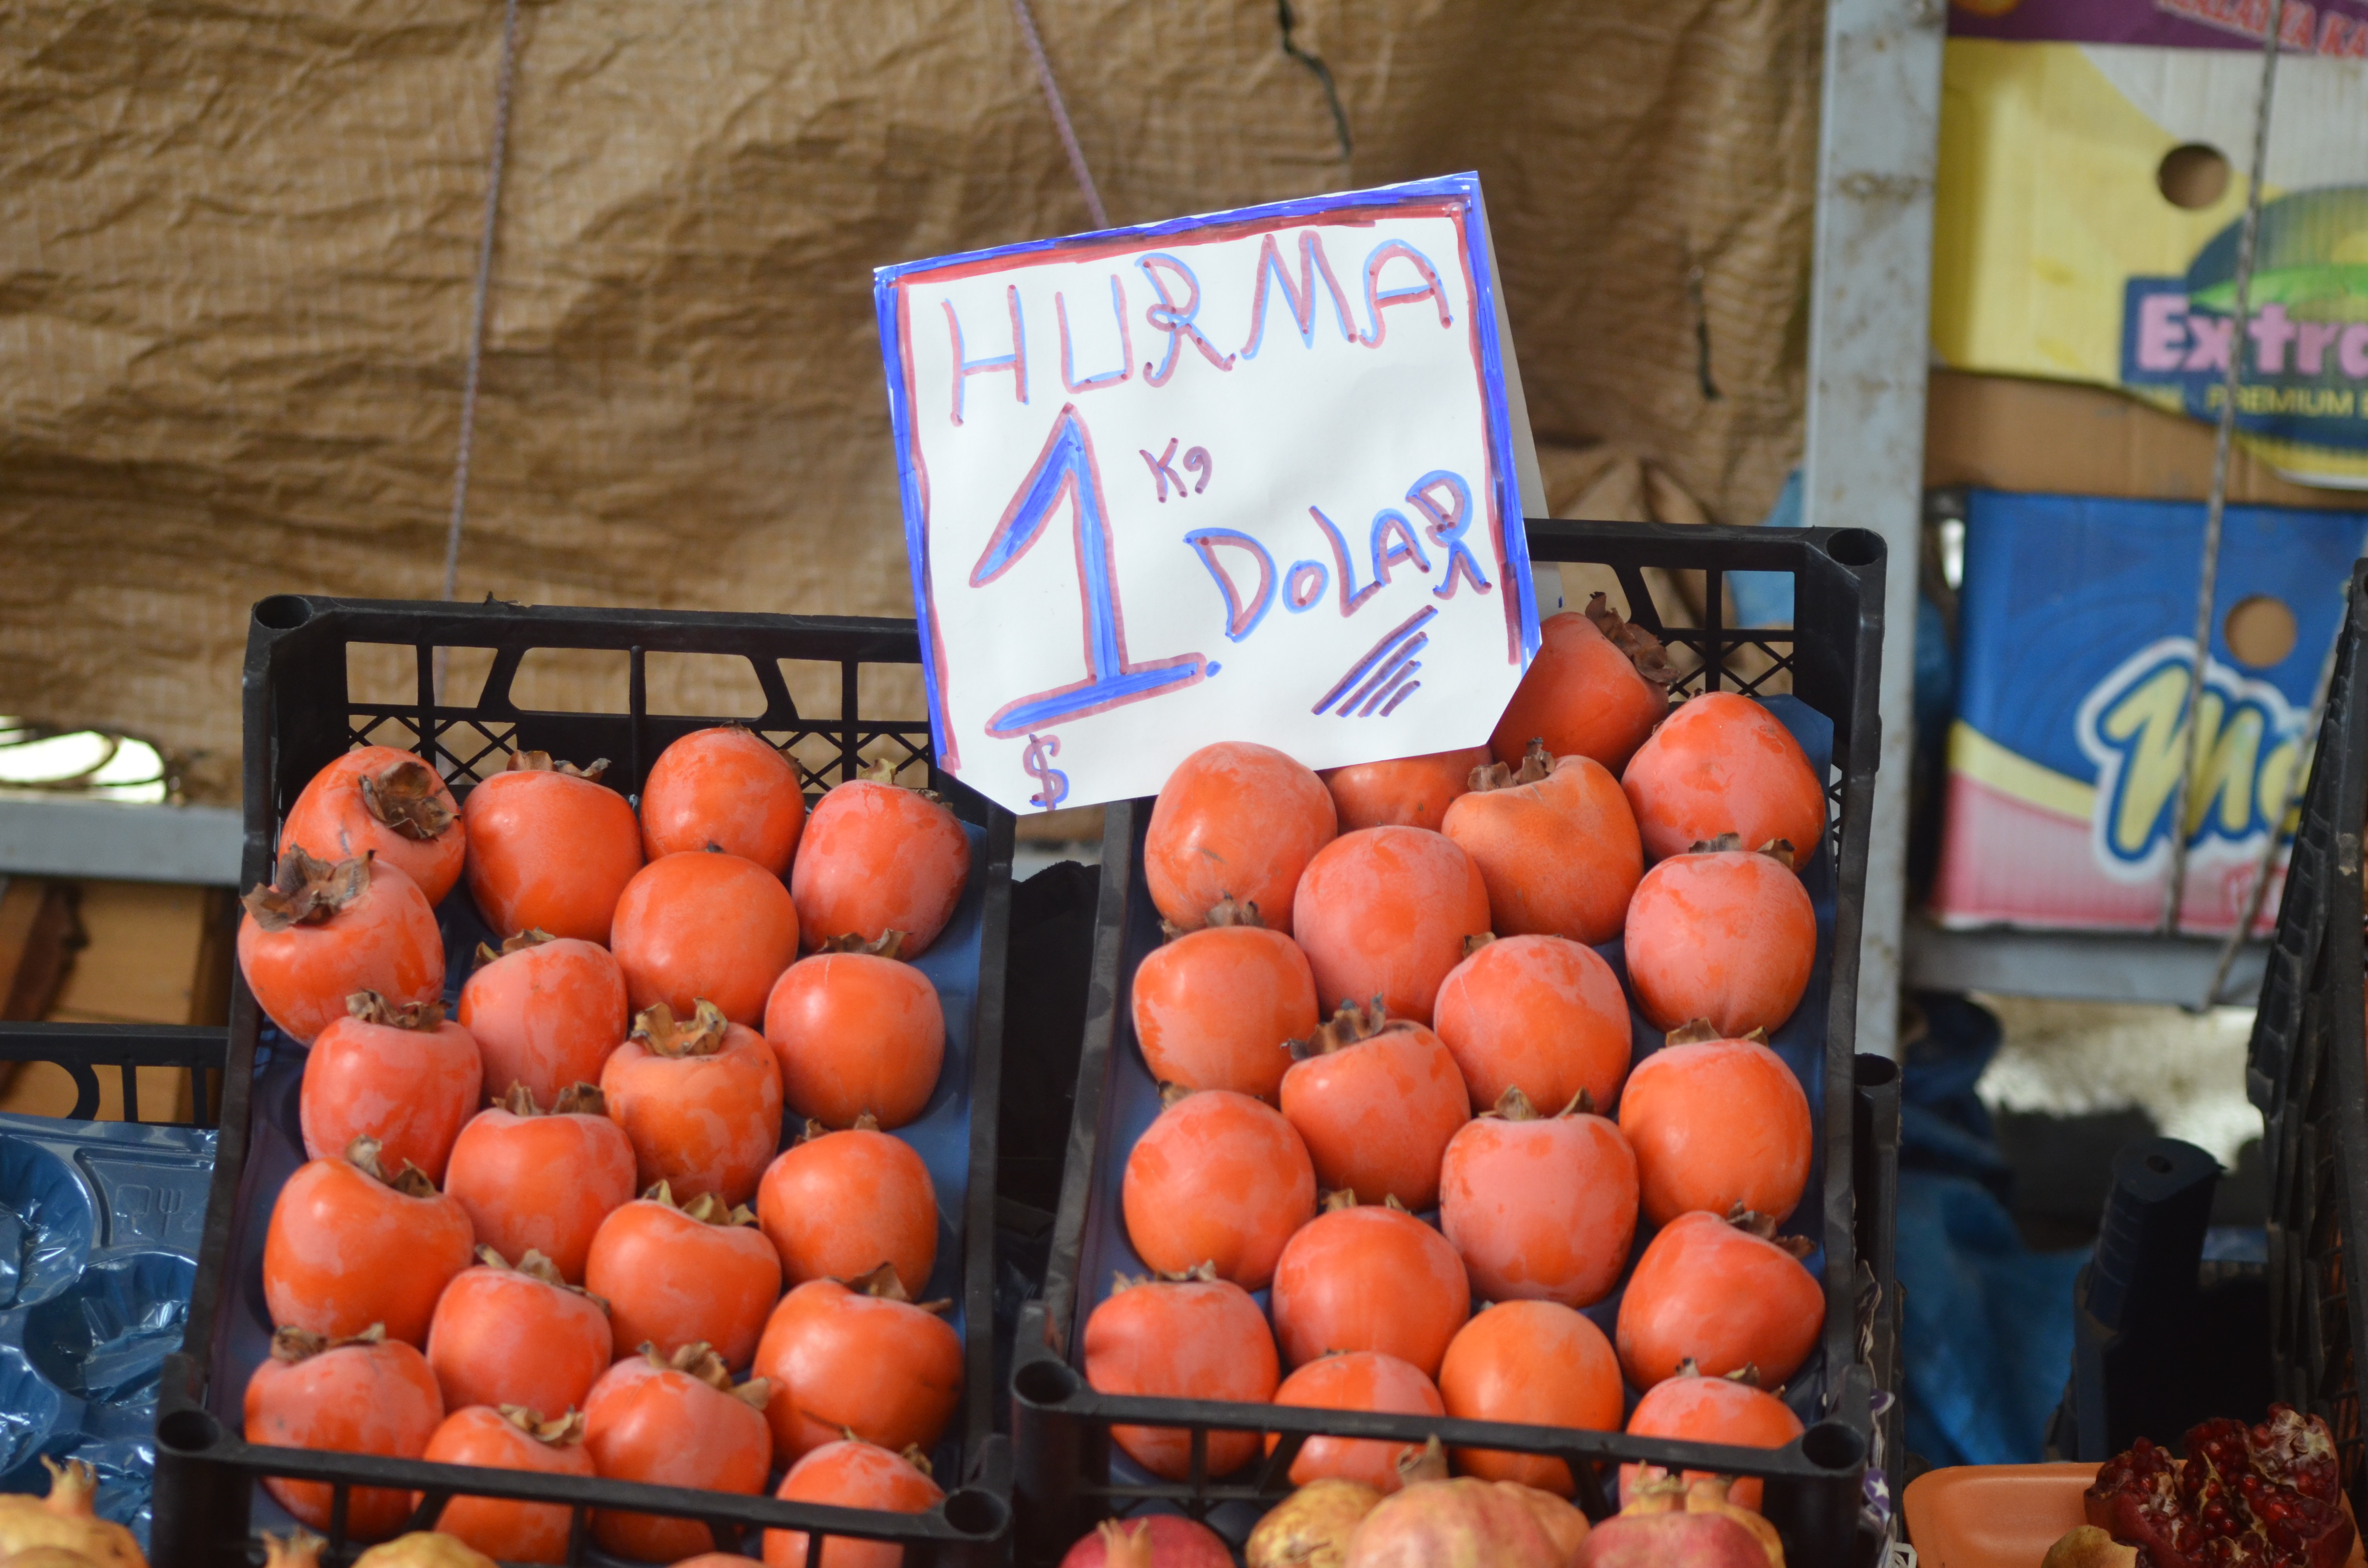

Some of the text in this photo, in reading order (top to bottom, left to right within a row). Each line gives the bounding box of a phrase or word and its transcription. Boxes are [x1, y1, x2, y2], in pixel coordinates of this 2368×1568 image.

[941, 231, 1454, 427] HURMA
[2207, 384, 2355, 417] PREMIUM
[1023, 733, 1070, 814] $
